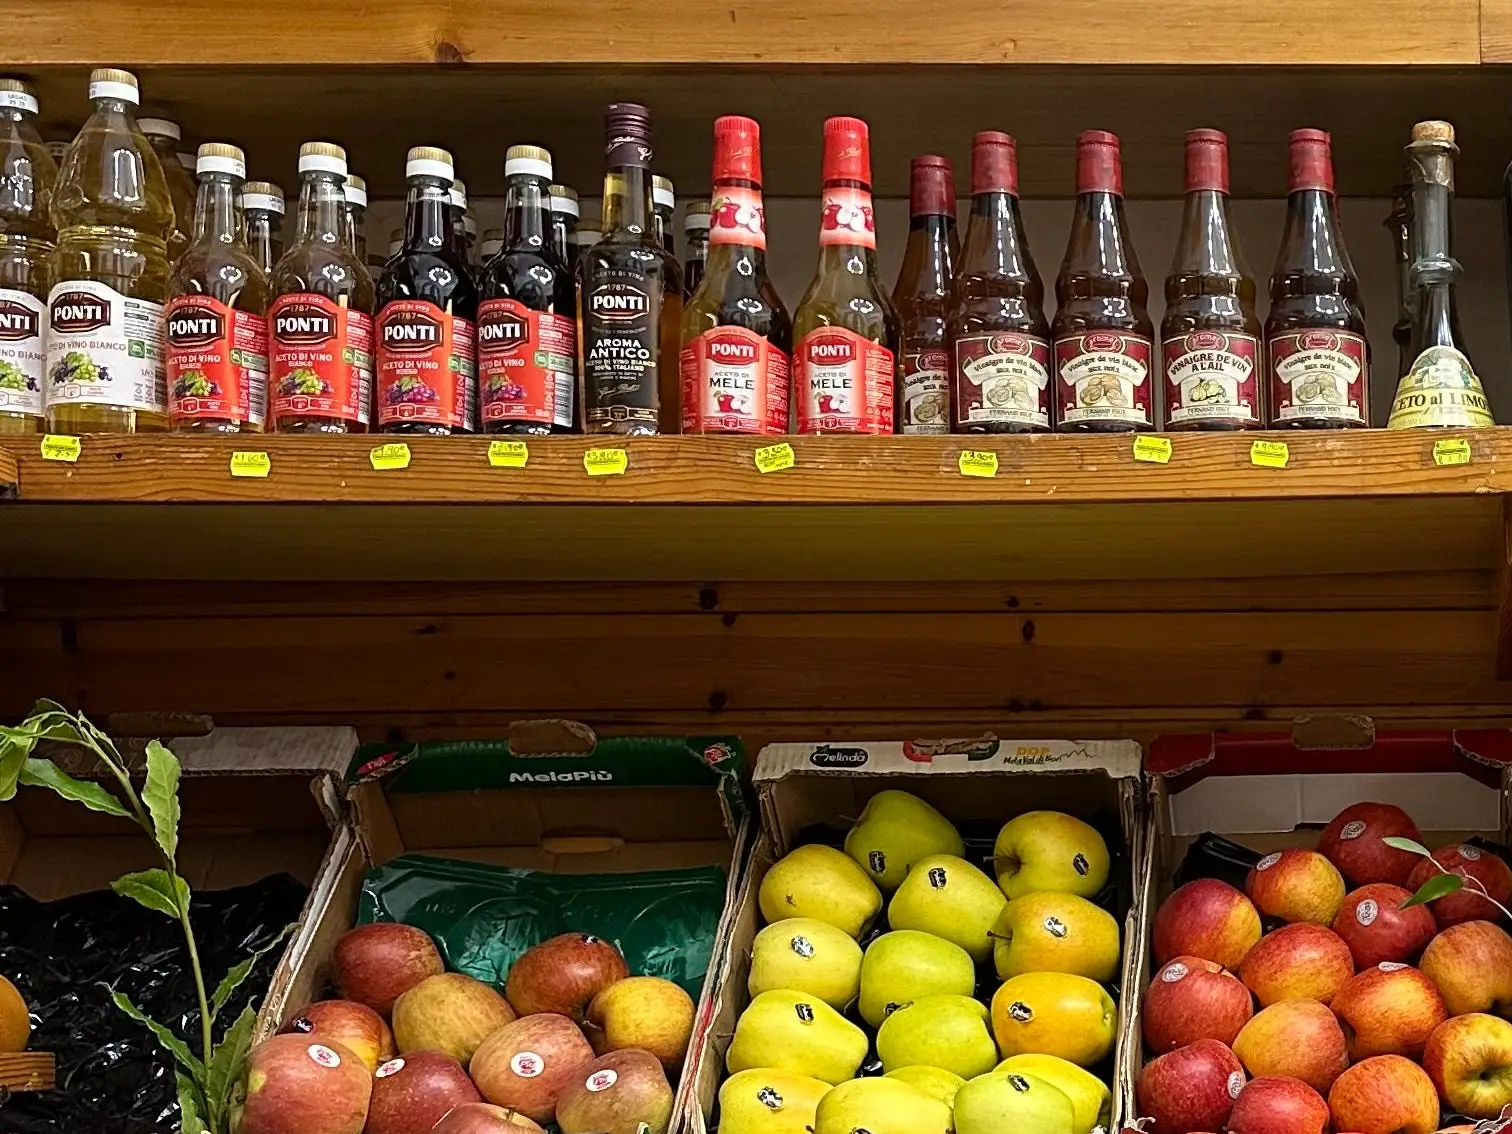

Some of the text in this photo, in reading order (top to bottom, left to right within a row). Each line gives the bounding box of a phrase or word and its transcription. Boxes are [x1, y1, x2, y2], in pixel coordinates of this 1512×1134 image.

[593, 295, 643, 310] PONTI
[54, 305, 102, 322] PONTI
[169, 319, 217, 336] PONTI
[276, 317, 329, 333] PONTI
[384, 326, 435, 341] PONTI
[478, 323, 521, 341] PONTI
[89, 340, 127, 352] BIANCO
[596, 339, 641, 348] AROMA
[589, 348, 650, 359] ANTICO
[711, 344, 754, 357] PONTI
[811, 344, 851, 357] PONTI
[1171, 353, 1248, 375] VINAIGRE DE VIN
[709, 378, 755, 390] MELE
[810, 378, 853, 390] MELE
[1430, 391, 1443, 405] al
[813, 750, 866, 763] Melinda
